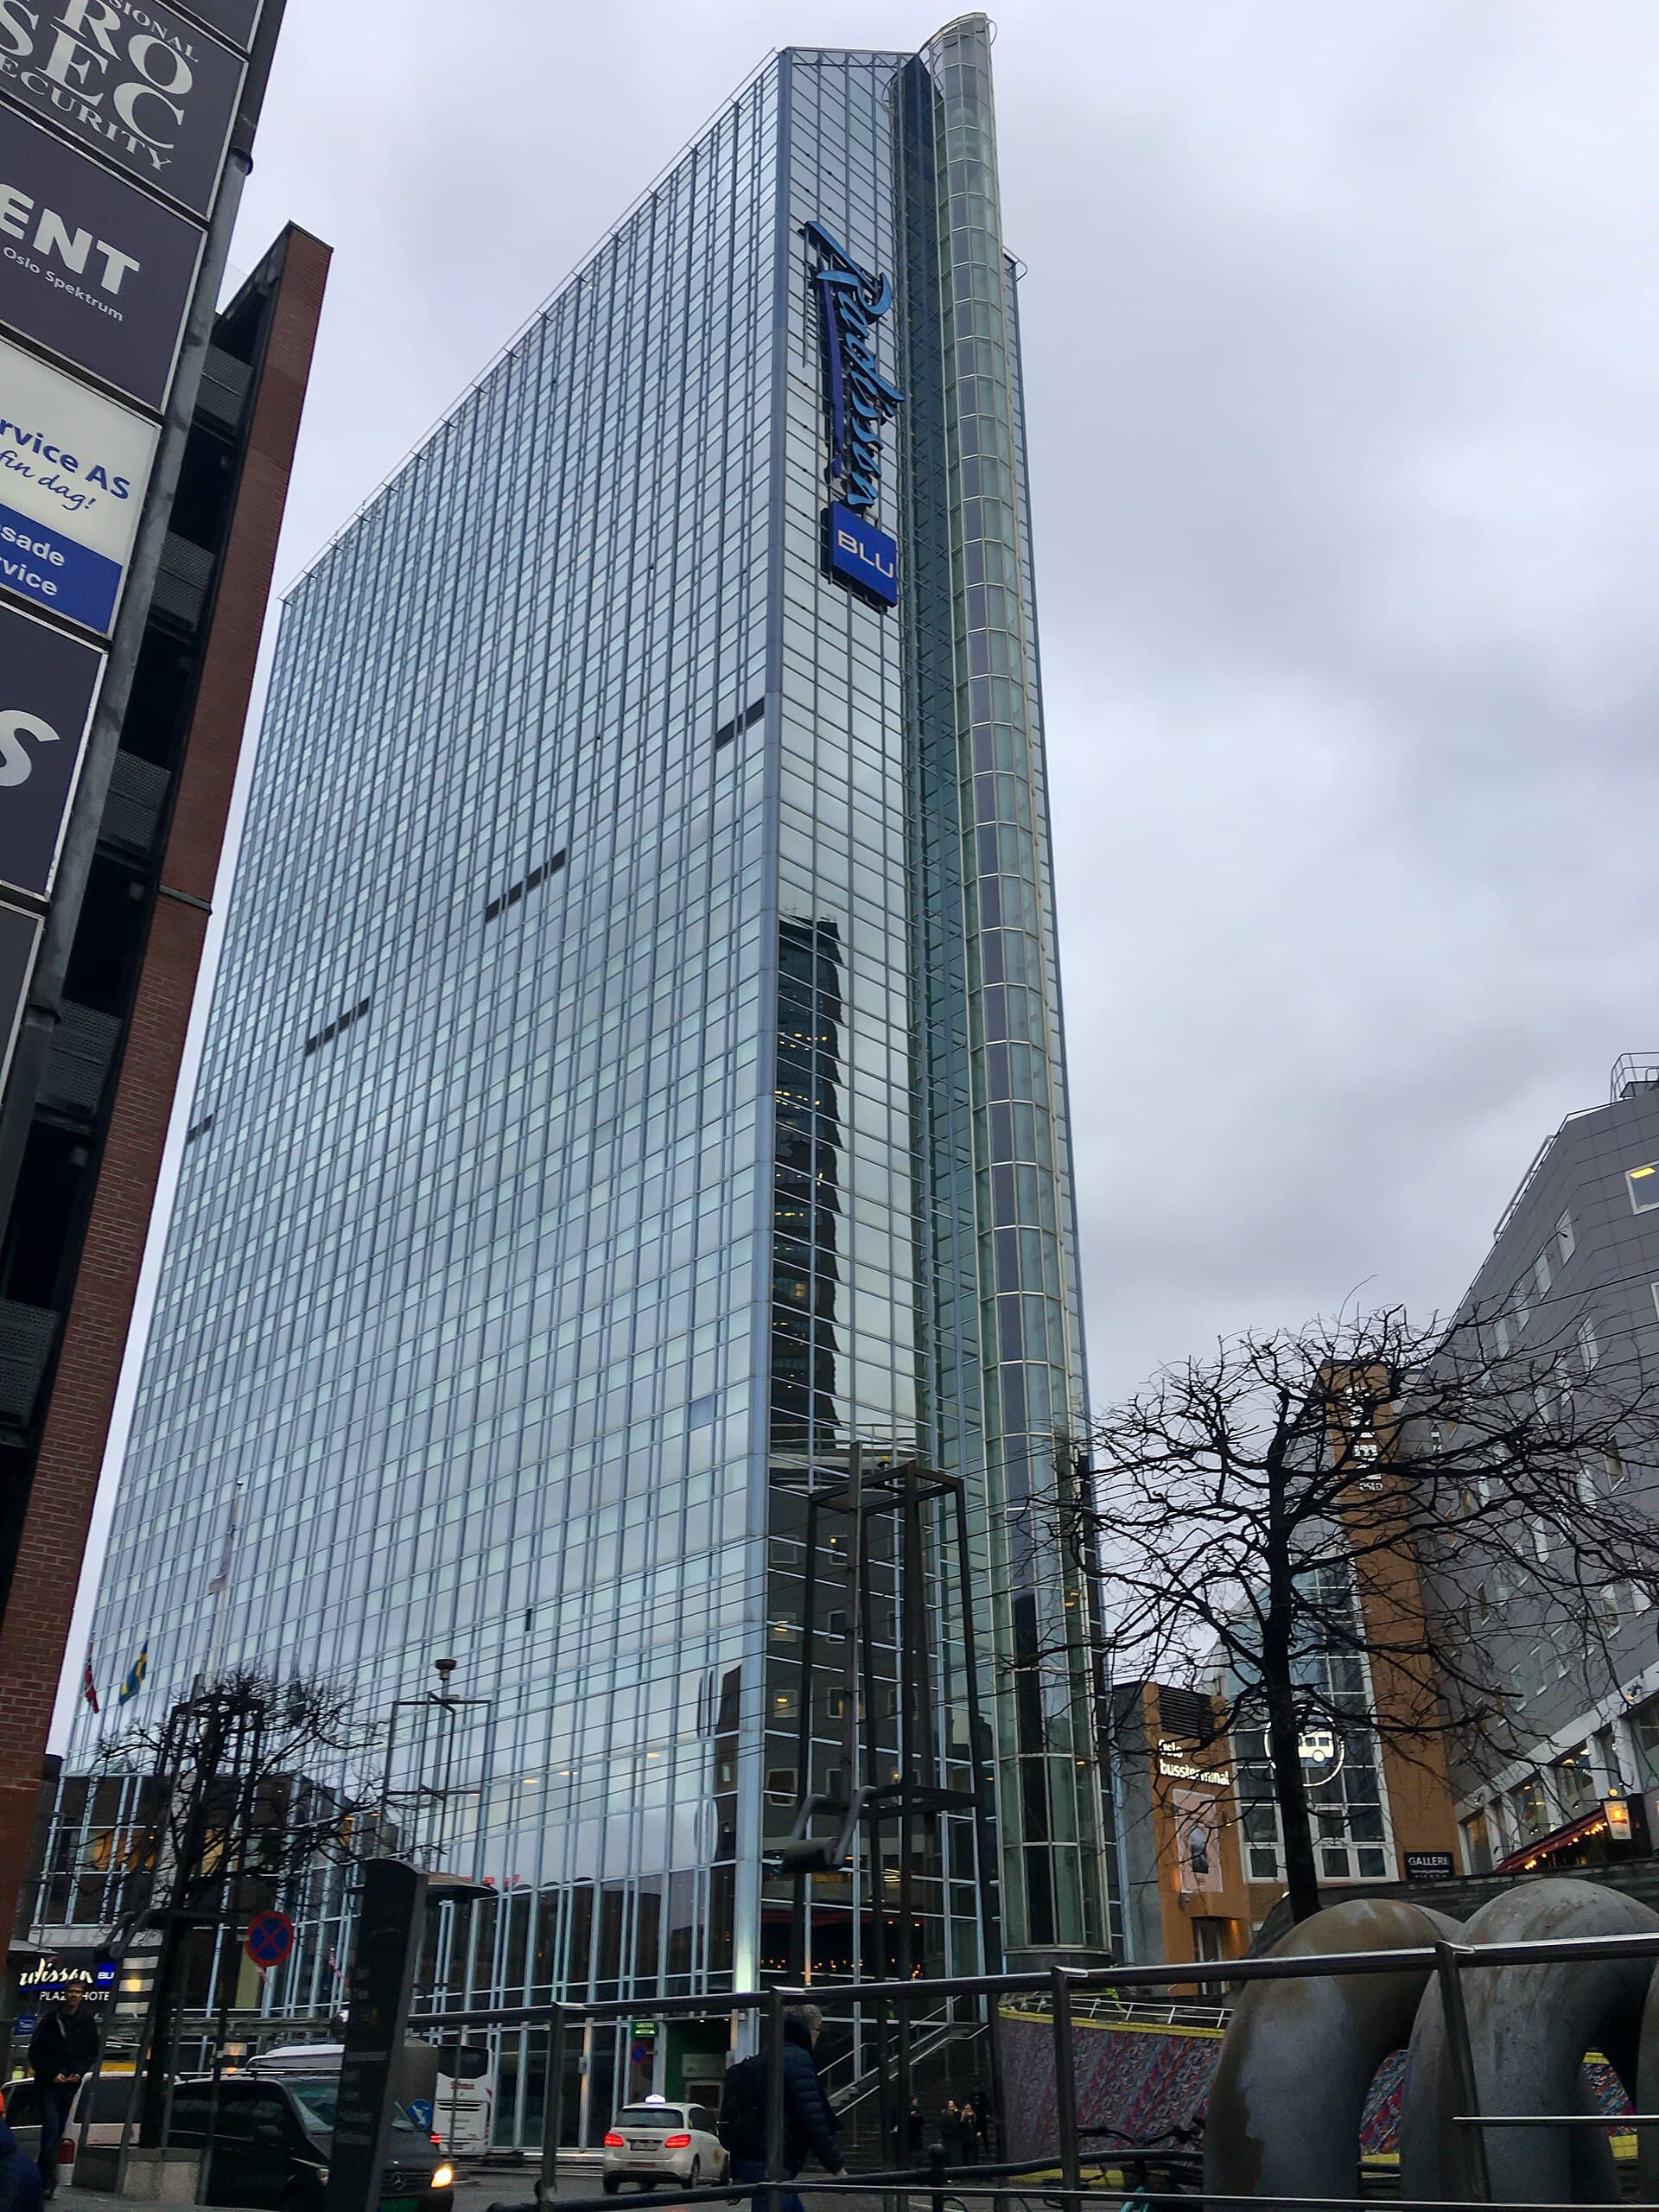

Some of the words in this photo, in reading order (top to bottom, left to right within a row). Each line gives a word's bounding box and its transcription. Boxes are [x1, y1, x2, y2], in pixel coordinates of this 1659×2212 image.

[0, 0, 185, 149] SEC
[0, 183, 140, 295] ENT
[3, 246, 41, 274] Oslo
[45, 270, 124, 321] Spektrum
[797, 221, 905, 508] Radisson
[0, 419, 78, 474] rvice
[85, 464, 130, 499] AS
[38, 474, 96, 511] dag!
[837, 528, 893, 579] BLU
